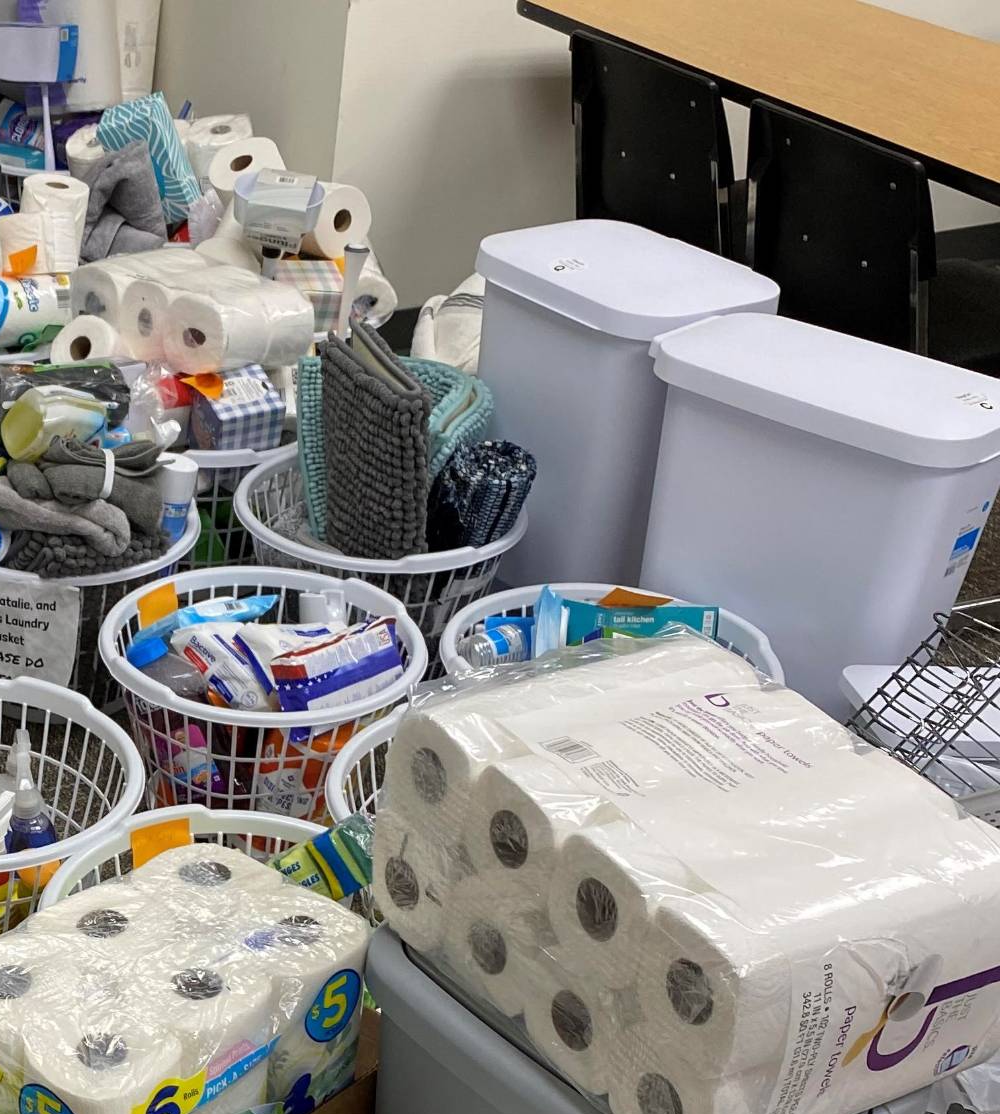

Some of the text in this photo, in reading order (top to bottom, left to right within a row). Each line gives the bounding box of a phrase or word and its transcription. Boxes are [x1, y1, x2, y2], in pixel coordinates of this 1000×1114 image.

[36, 601, 57, 612] and
[5, 614, 50, 632] Laundry
[626, 614, 655, 624] kitchen
[25, 657, 44, 668] DO
[756, 731, 786, 750] paper
[823, 972, 832, 1003] ROLLS
[311, 975, 347, 1028] $5
[814, 992, 821, 1002] 11
[838, 1005, 857, 1052] paper
